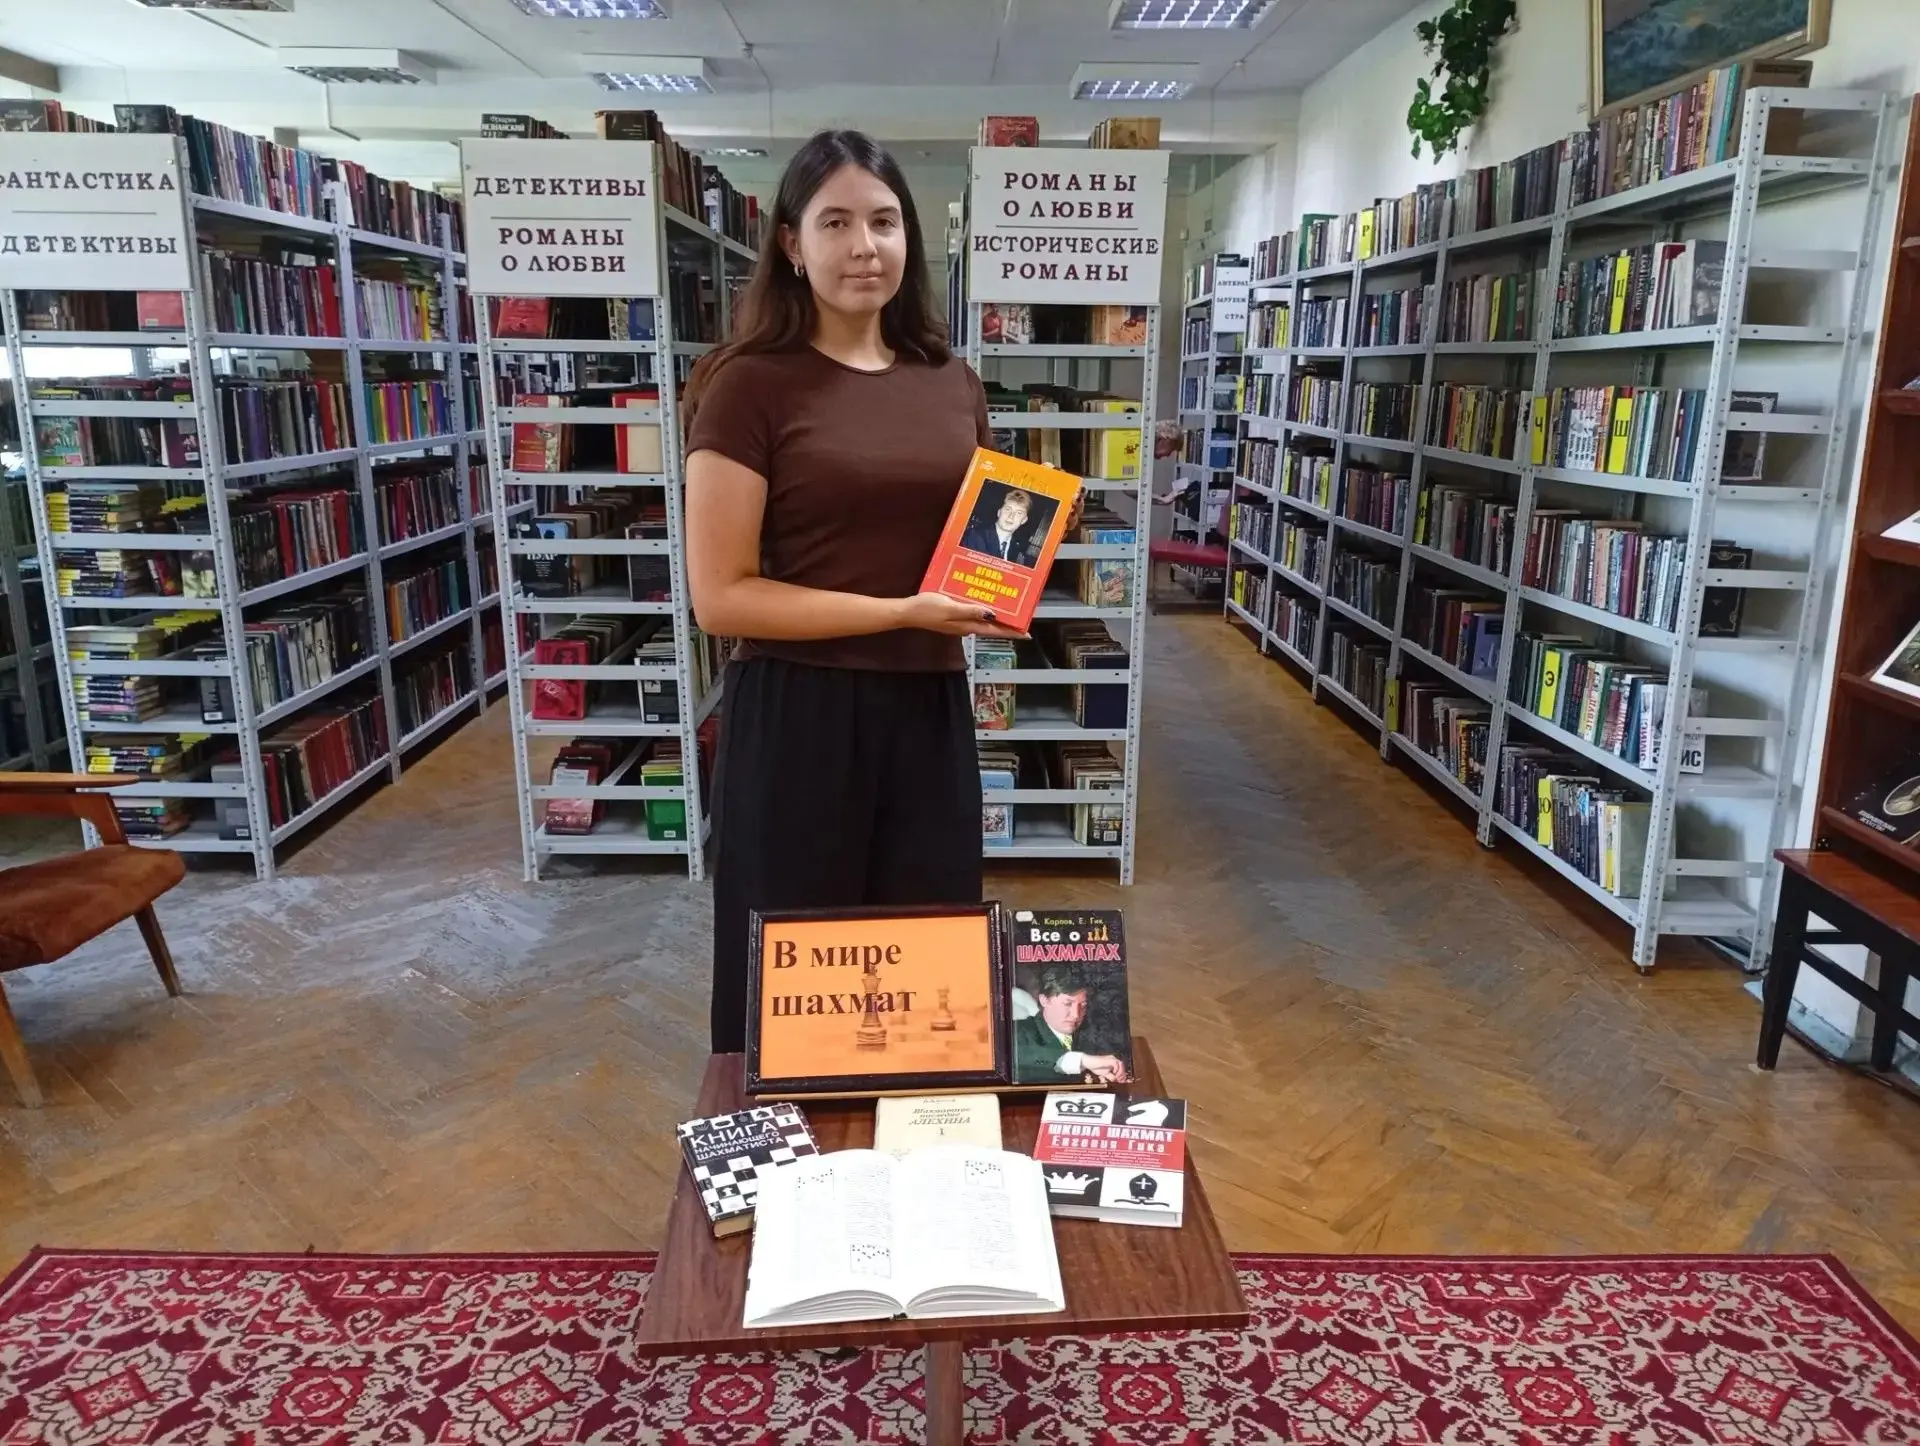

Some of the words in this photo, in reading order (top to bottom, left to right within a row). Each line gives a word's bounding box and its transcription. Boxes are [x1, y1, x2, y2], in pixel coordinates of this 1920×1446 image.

[473, 177, 646, 197] ДЕТЕКТИВЫ
[1004, 172, 1137, 192] РОМАНЫ
[1003, 200, 1020, 217] О
[1029, 200, 1134, 219] ЛЮБВИ
[0, 235, 178, 255] ДЕТЕКТИВЫ
[498, 227, 625, 246] РОМАНЫ
[973, 235, 1160, 255] ИСТОРИЧЕСКИЕ
[501, 254, 518, 272] О
[527, 255, 626, 273] ЛЮБВИ
[1000, 262, 1129, 282] РОМАНЫ
[1535, 421, 1543, 433] Ч
[1614, 419, 1629, 437] Ш
[1544, 670, 1555, 687] Э
[1538, 797, 1552, 814] Ю
[1043, 917, 1075, 927] Карпов,
[1030, 927, 1061, 942] Все
[1068, 930, 1081, 942] о
[772, 940, 798, 969] В
[810, 942, 902, 975] мире
[1016, 943, 1122, 963] ШАХМАТАХ
[771, 990, 917, 1017] шахмат
[908, 1116, 971, 1126] АЛЕХИНА
[689, 1120, 779, 1149] КНИГА
[695, 1130, 781, 1155] НАЧИНАЮЩЕГО
[1047, 1123, 1101, 1138] ШКОЛА
[1106, 1127, 1174, 1143] ШАХМАТ
[696, 1135, 785, 1161] ШАХМАТИСТА
[1051, 1135, 1118, 1150] Евгения
[1127, 1139, 1166, 1153] Гика
